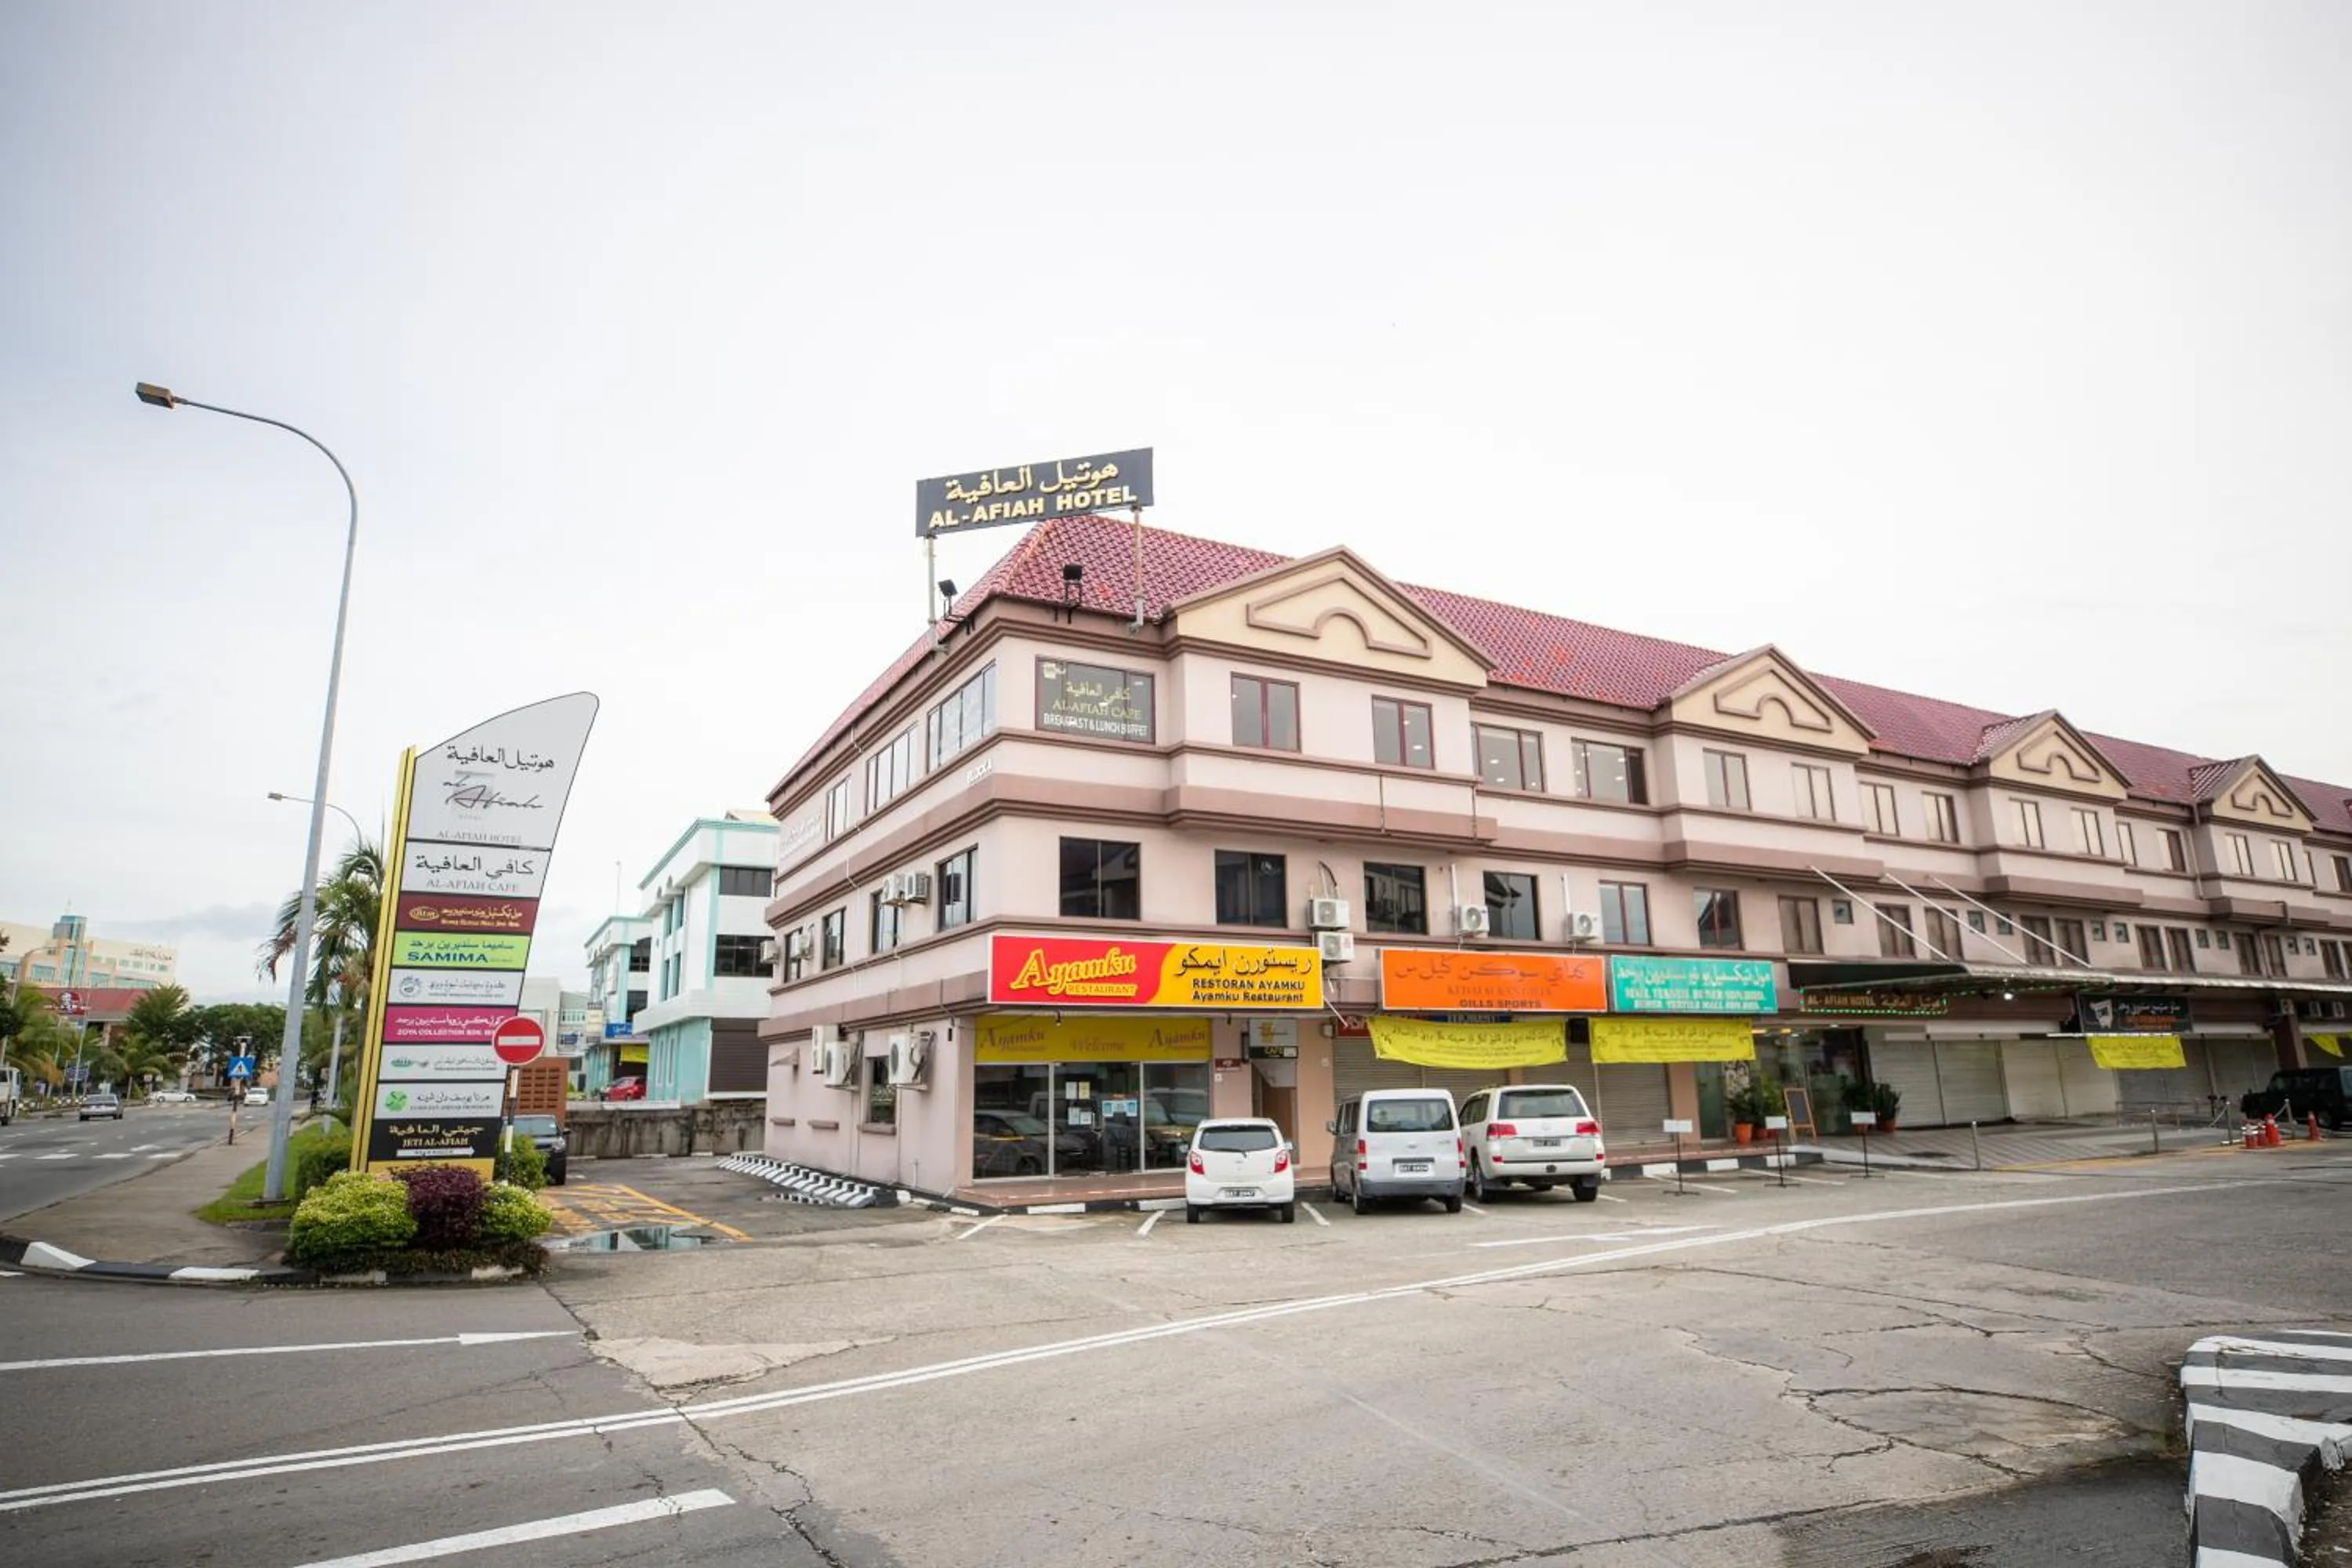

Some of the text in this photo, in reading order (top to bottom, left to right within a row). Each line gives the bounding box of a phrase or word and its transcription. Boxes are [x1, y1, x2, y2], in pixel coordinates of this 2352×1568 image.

[929, 486, 1138, 528] AL-AFIAH HOTEL
[1096, 720, 1120, 734] LUNCH
[488, 882, 519, 892] CAFE
[407, 951, 488, 963] SAMIMA
[1010, 946, 1138, 995] Ayamku
[1068, 984, 1135, 994] RESTAURANT
[1192, 978, 1305, 990] RESTORAN AYAMKU
[1192, 990, 1304, 1003] Ayamku Restaurant
[1497, 999, 1541, 1009] SPORTS
[980, 1026, 1206, 1053] Ayamku Welcome Ayamku
